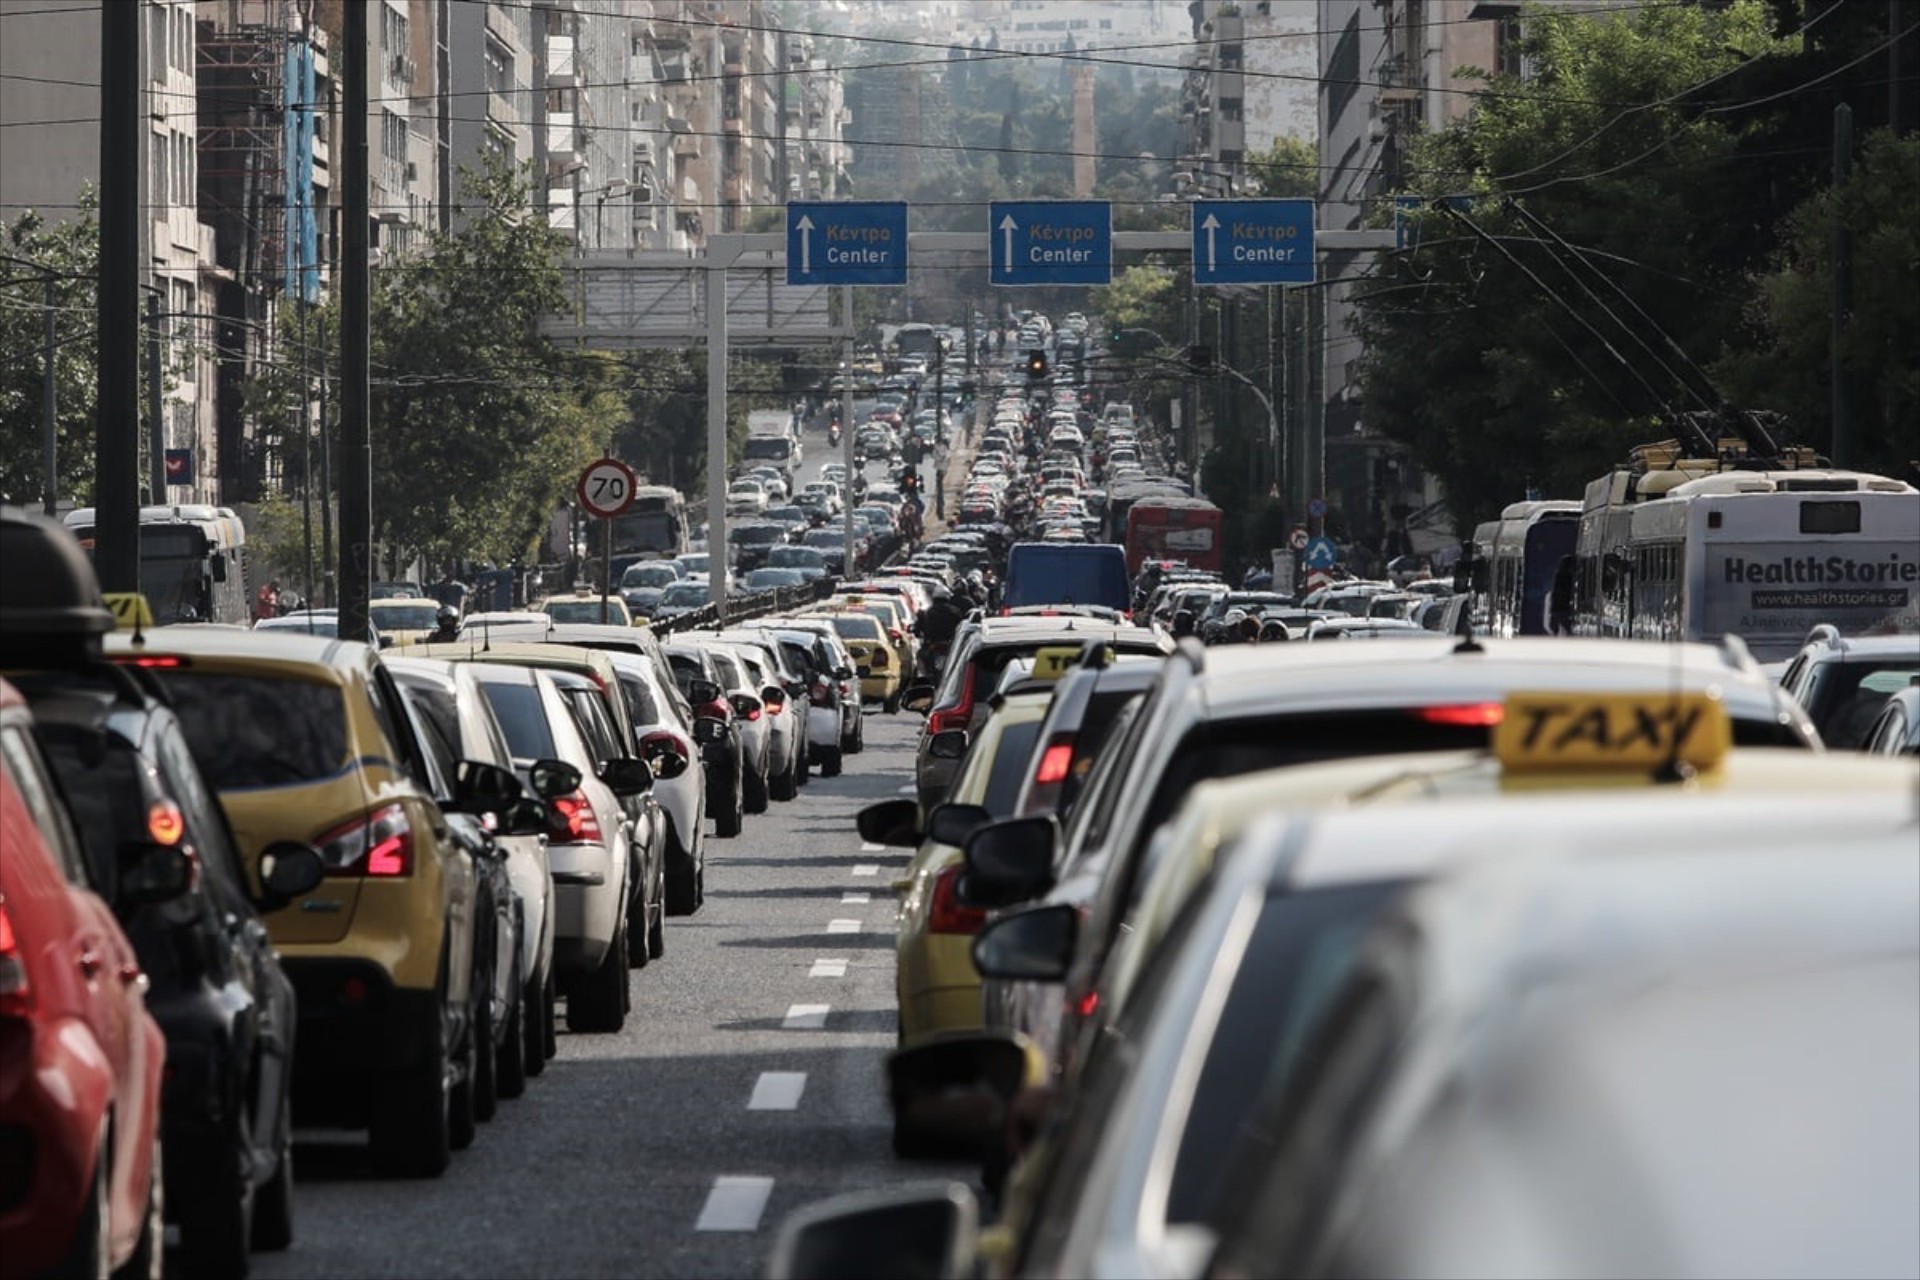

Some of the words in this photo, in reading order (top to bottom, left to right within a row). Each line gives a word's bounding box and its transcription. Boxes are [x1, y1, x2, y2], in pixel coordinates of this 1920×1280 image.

[826, 224, 891, 244] Κέντρο
[1029, 224, 1095, 243] Κέντρο
[1232, 221, 1298, 241] Κέντρο
[827, 247, 889, 263] Center
[1029, 246, 1092, 262] Center
[1233, 245, 1295, 261] Center
[592, 477, 624, 499] 70
[1725, 553, 1920, 584] HealthStorie
[1755, 591, 1904, 608] www.healthstories.gr
[1521, 704, 1704, 748] TAXI
